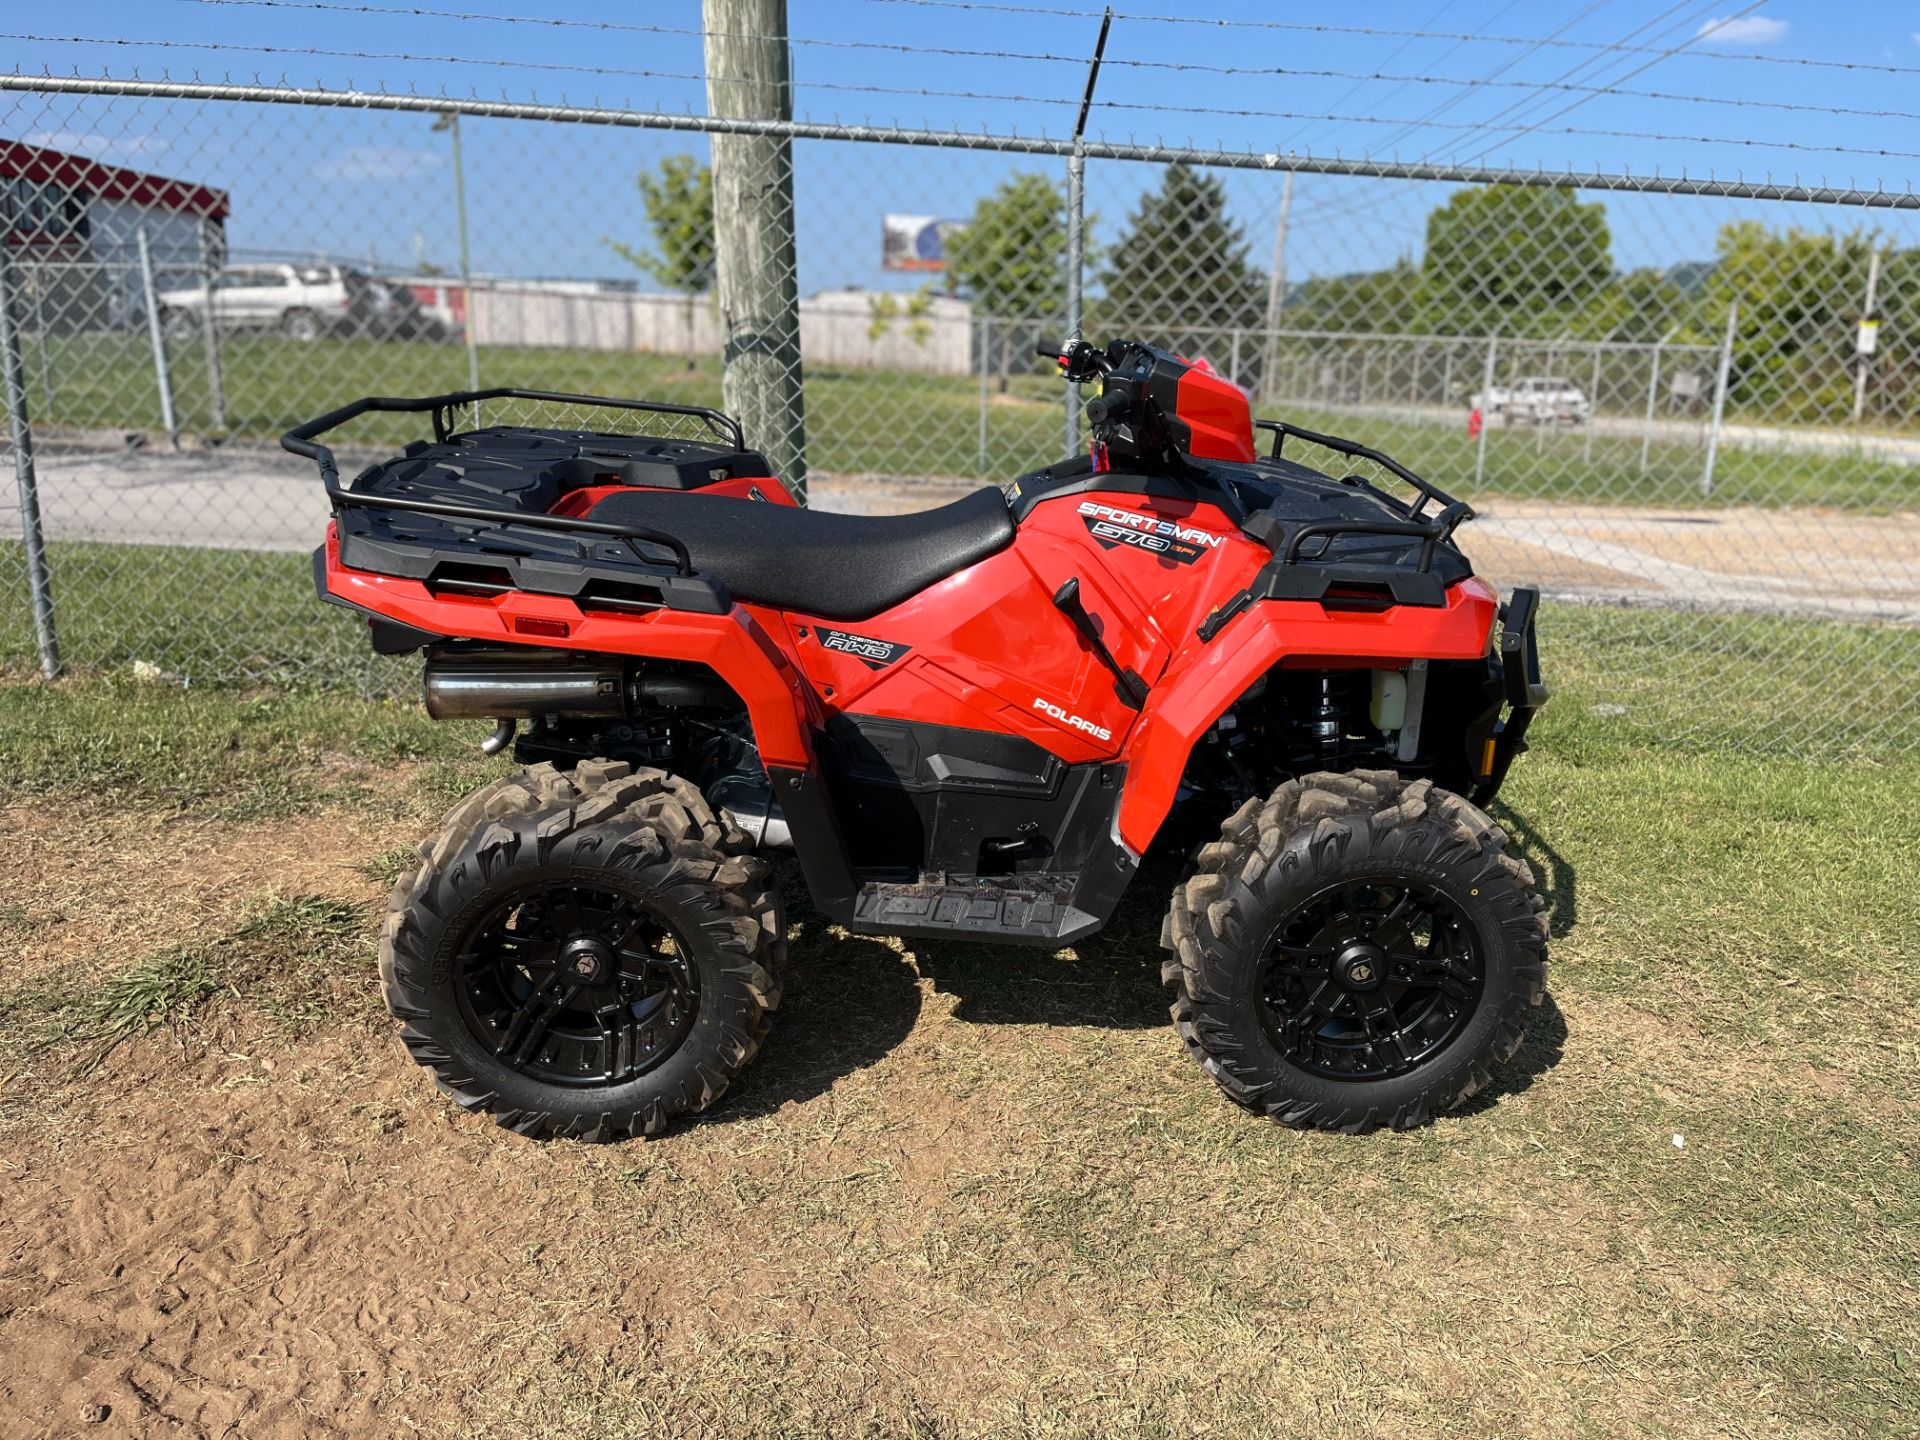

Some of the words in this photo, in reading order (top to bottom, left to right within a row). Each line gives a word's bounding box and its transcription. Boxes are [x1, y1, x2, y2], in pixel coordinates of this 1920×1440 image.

[1077, 502, 1223, 548] SPORTSMAN
[1091, 521, 1171, 552] 570
[824, 636, 891, 659] AWD
[849, 636, 893, 648] DEMAND
[1033, 698, 1111, 740] POLARIS
